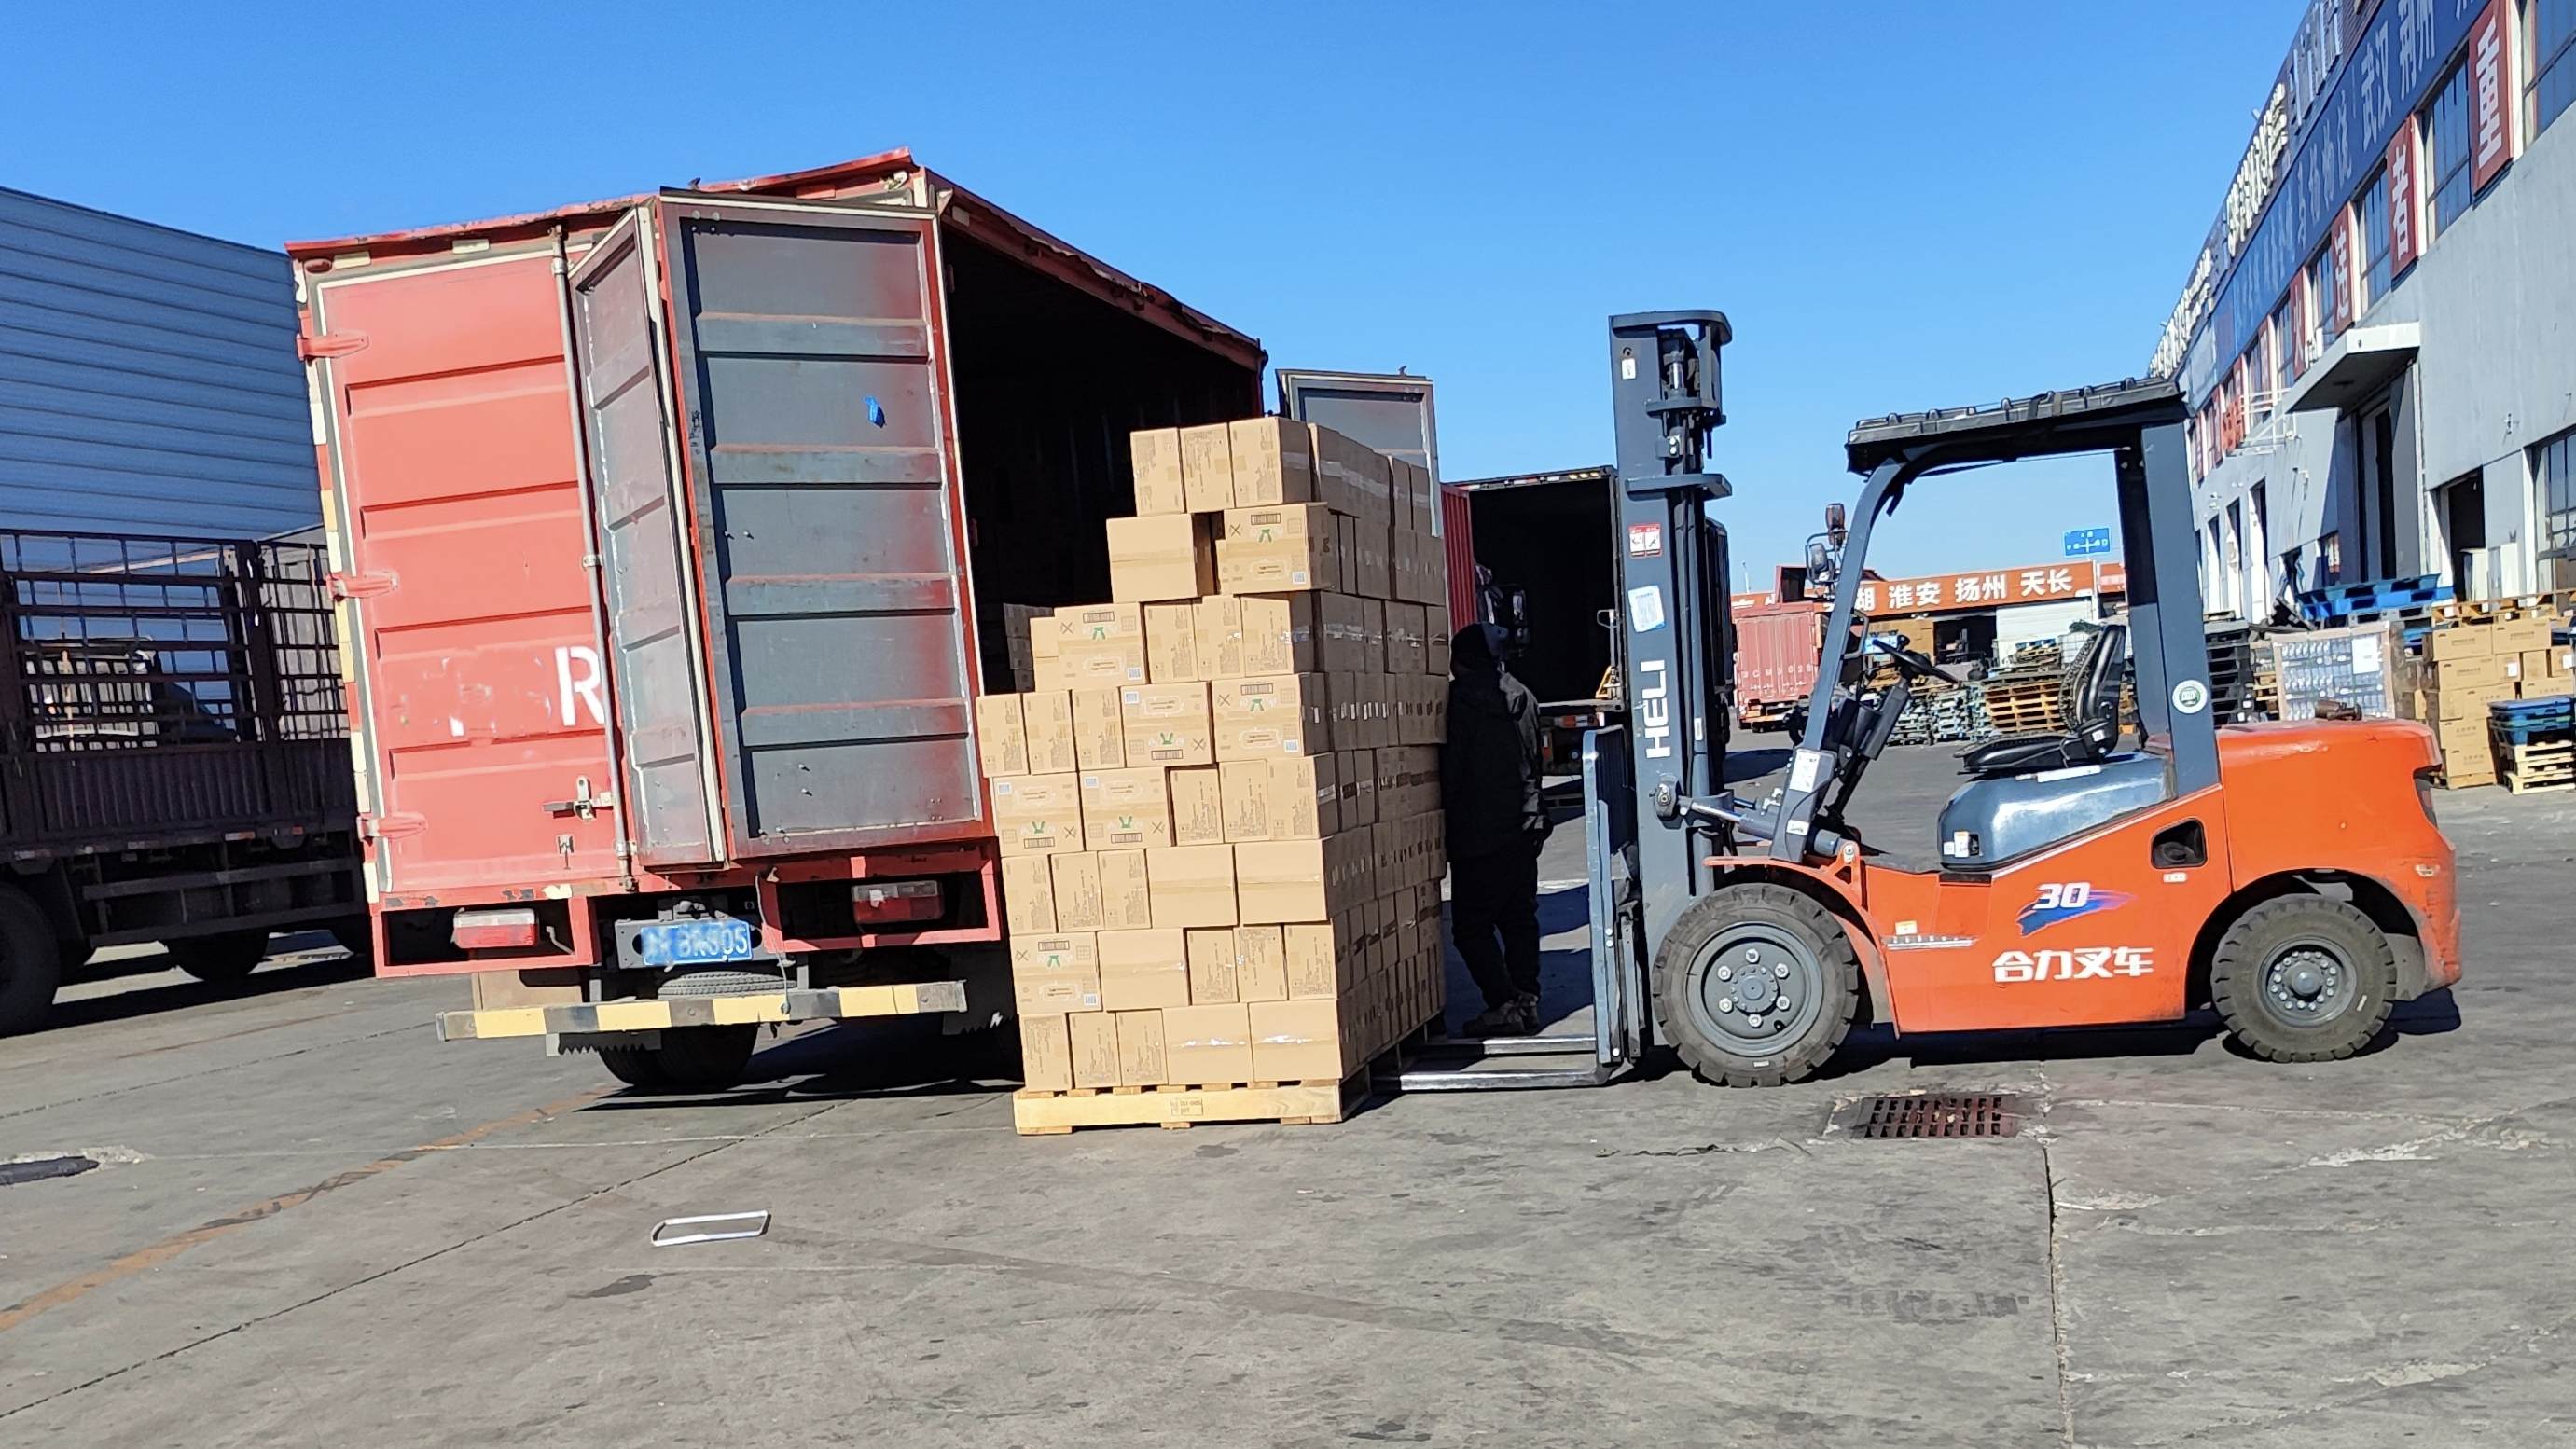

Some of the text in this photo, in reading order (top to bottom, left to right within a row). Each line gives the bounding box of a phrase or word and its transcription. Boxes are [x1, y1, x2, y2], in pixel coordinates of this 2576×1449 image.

[2361, 20, 2392, 152] 武汉
[2391, 143, 2409, 261] 者
[2475, 15, 2503, 170] 重
[1888, 581, 1941, 609] 淮安
[1955, 574, 2006, 602] 扬州
[2020, 568, 2073, 597] 天长
[554, 645, 605, 727] R
[1640, 659, 1671, 759] HELI
[2033, 882, 2091, 910] 30
[1991, 946, 2154, 983] 合力叉车
